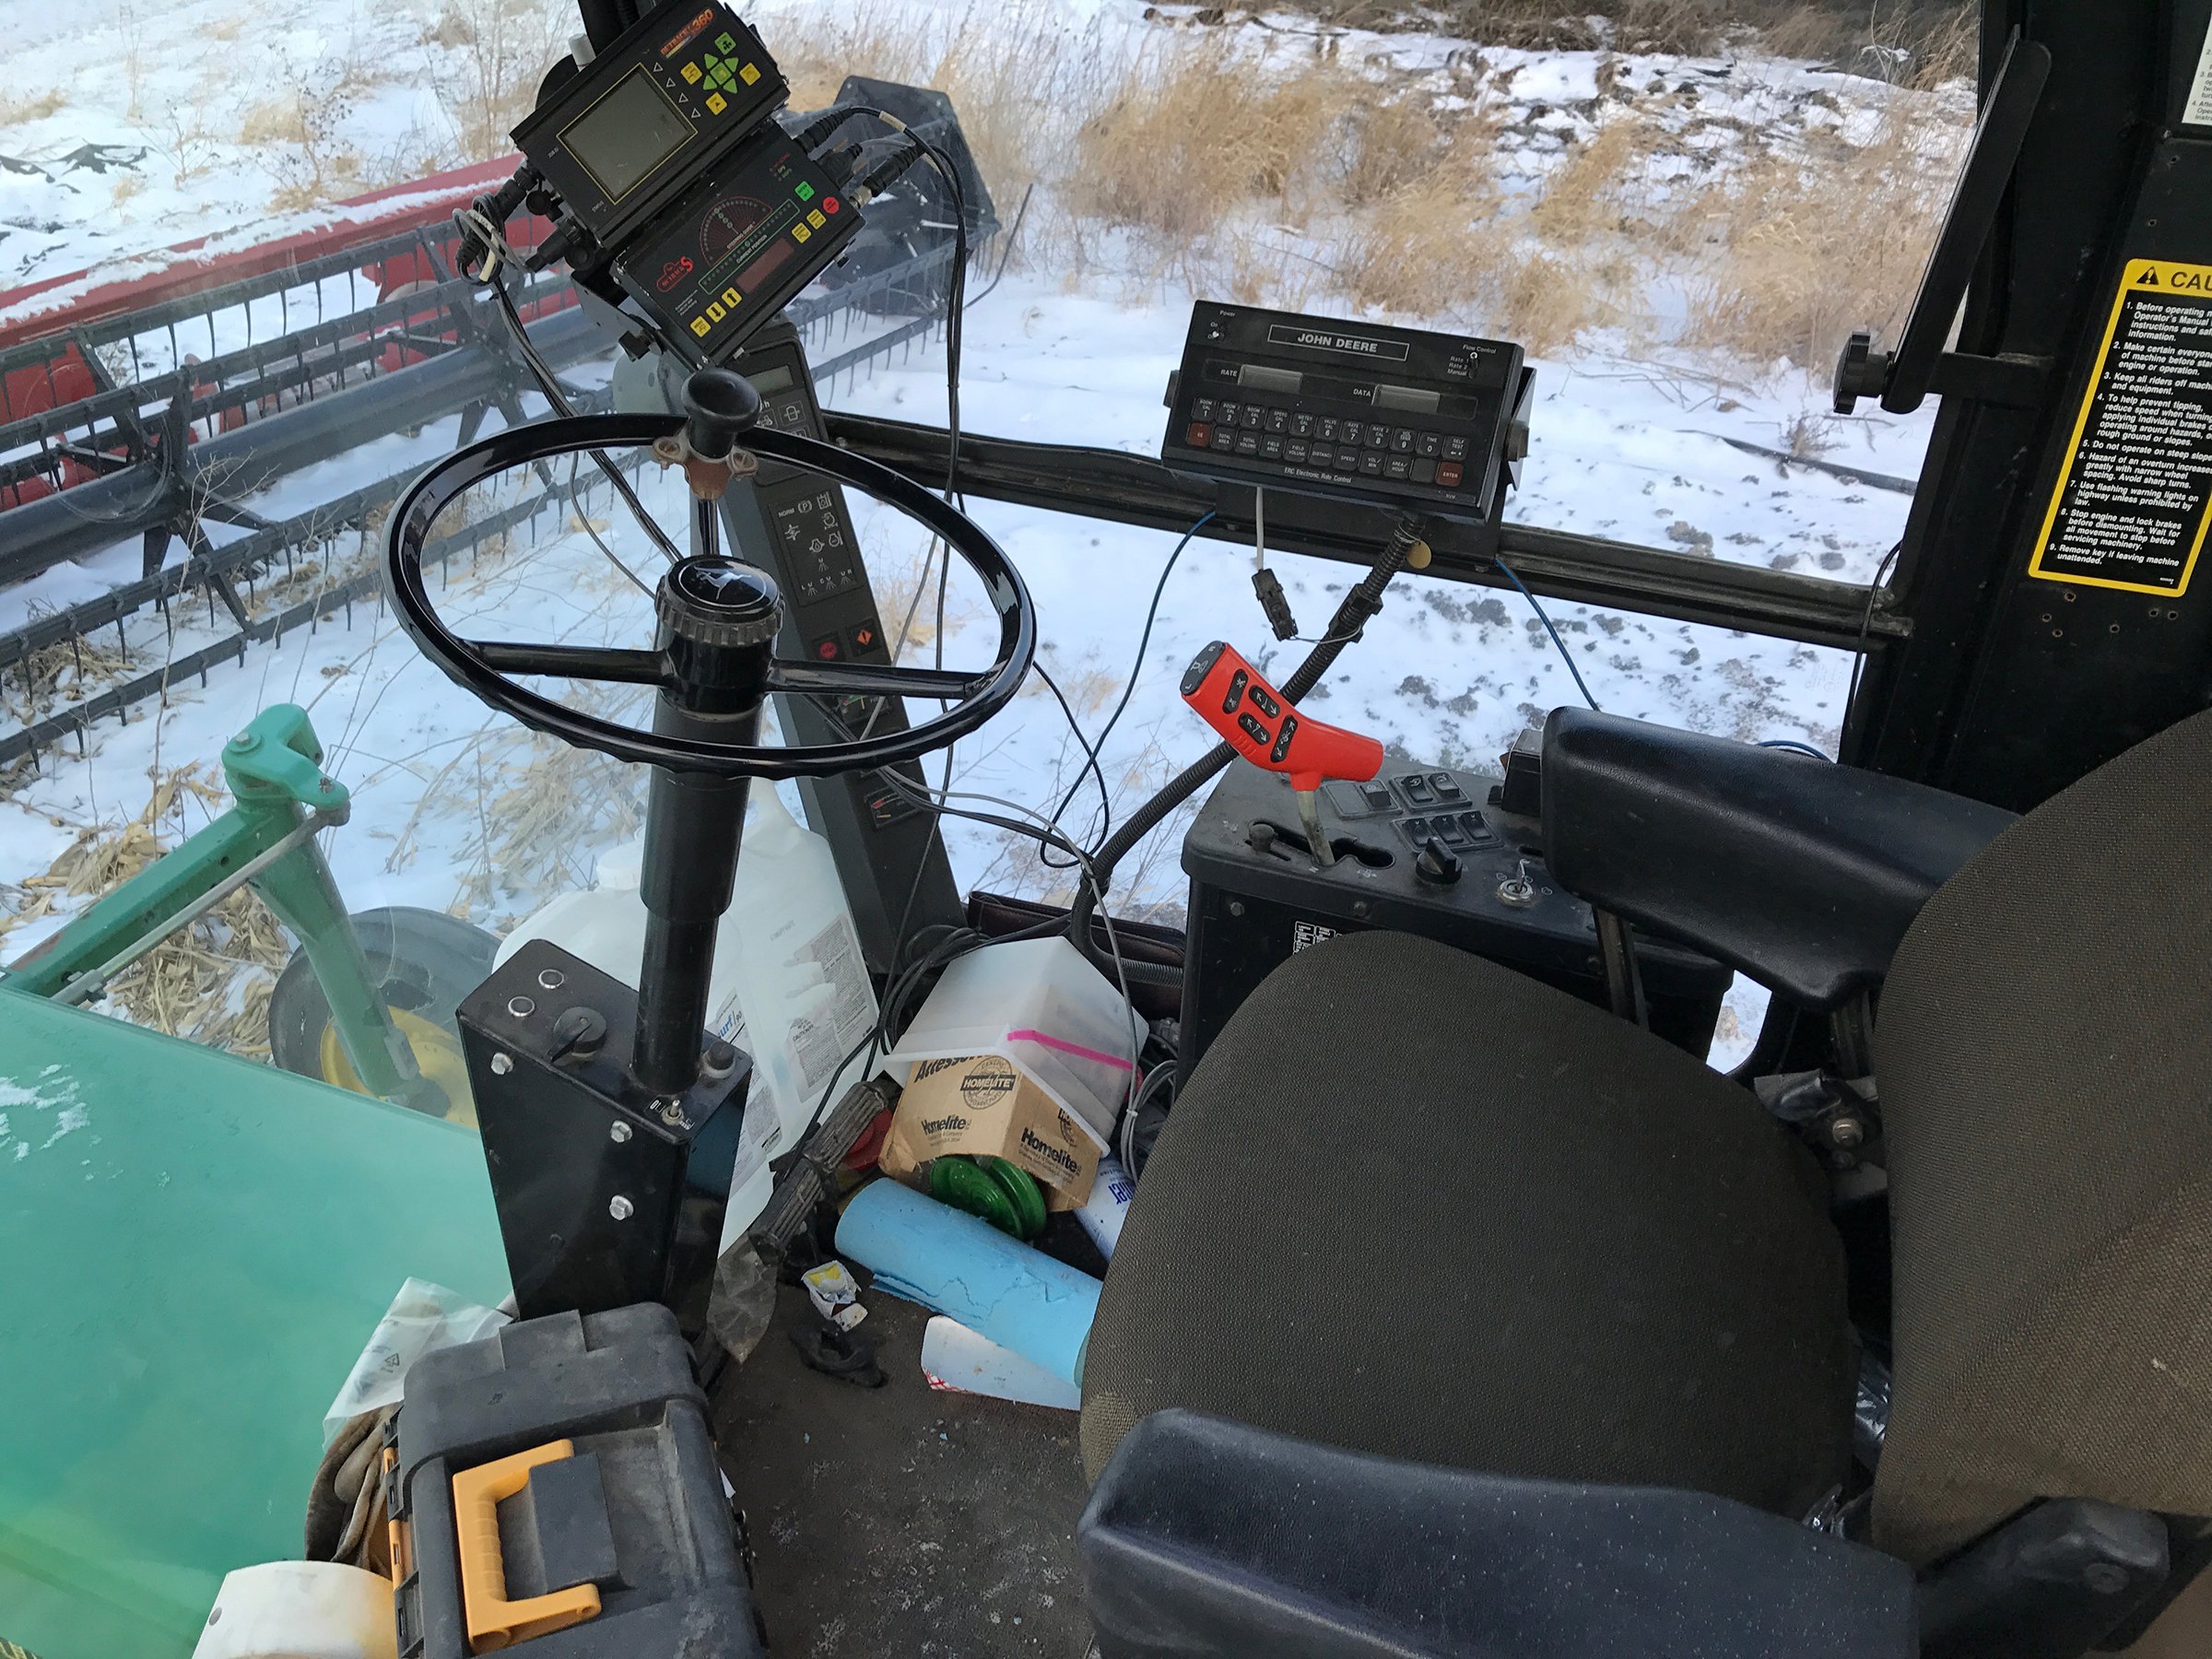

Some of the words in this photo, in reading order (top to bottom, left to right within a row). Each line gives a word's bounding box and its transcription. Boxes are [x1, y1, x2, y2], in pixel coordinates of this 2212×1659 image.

[692, 8, 714, 28] 360
[2134, 311, 2177, 323] Operator's
[2179, 317, 2209, 326] Manual
[2136, 302, 2164, 312] Before
[2165, 306, 2205, 318] operating
[2131, 320, 2179, 332] instructions
[1298, 333, 1332, 346] JOHN
[1336, 339, 1378, 353] DEERE
[2128, 329, 2176, 341] information.
[2123, 342, 2145, 351] Make
[2147, 346, 2176, 354] certain
[2118, 361, 2146, 370] engine
[2159, 365, 2200, 375] operation.
[2132, 354, 2166, 363] machine
[2168, 356, 2196, 366] before
[2114, 372, 2135, 383] Keep
[2149, 376, 2173, 386] riders
[2129, 384, 2173, 395] equipment.
[2105, 403, 2133, 413] reduce
[2134, 406, 2160, 417] speed
[2162, 409, 2184, 418] when
[2109, 393, 2118, 402] To
[2120, 395, 2138, 406] help
[2139, 399, 2171, 409] prevent
[2173, 401, 2203, 413] tipping,
[2100, 419, 2138, 432] operating
[2139, 425, 2169, 434] around
[2170, 427, 2203, 439] hazards,
[2102, 412, 2136, 424] applying
[2138, 415, 2178, 426] individual
[2179, 419, 2206, 430] brakes
[2097, 428, 2120, 439] rough
[2122, 431, 2152, 441] ground
[2164, 436, 2192, 446] slopes.
[2093, 440, 2104, 449] Do
[2121, 445, 2152, 454] operate
[2167, 450, 2189, 460] steep
[2089, 452, 2117, 462] Hazard
[2141, 460, 2175, 469] overturn
[1296, 468, 1319, 478] Electronic
[2083, 469, 2116, 481] spacing.
[2118, 473, 2143, 483] Avoid
[2144, 476, 2166, 487] sharp
[2168, 479, 2191, 489] turns.
[2085, 462, 2114, 472] greatly
[2116, 465, 2132, 473] with
[2134, 468, 2163, 477] narrow
[2164, 471, 2189, 480] wheel
[2080, 481, 2095, 490] Use
[2097, 483, 2128, 496] flashing
[2131, 488, 2162, 499] warning
[2164, 491, 2186, 502] lights
[2074, 497, 2090, 506] law.
[2077, 489, 2110, 501] highway
[2112, 494, 2138, 503] unless
[2139, 498, 2181, 508] prohibited
[2182, 502, 2193, 512] by
[2068, 517, 2094, 527] before
[2095, 520, 2145, 535] dismounting.
[2149, 527, 2167, 536] Wait
[2168, 529, 2181, 538] for
[2070, 509, 2089, 520] Stop
[2091, 513, 2117, 522] engine
[2136, 517, 2154, 526] lock
[2155, 519, 2182, 530] brakes
[2063, 534, 2098, 546] servicing
[2100, 539, 2142, 551] machinery.
[2077, 528, 2118, 538] movement
[2130, 533, 2148, 543] stop
[2150, 535, 2176, 545] before
[2057, 554, 2103, 565] unattended.
[2059, 545, 2091, 555] Remove
[2091, 548, 2107, 559] key
[2116, 552, 2145, 563] leaving
[2146, 557, 2179, 566] machine
[963, 1078, 1011, 1088] HOMELITE
[921, 1115, 966, 1136] Homelite
[1021, 1127, 1077, 1173] Homelite
